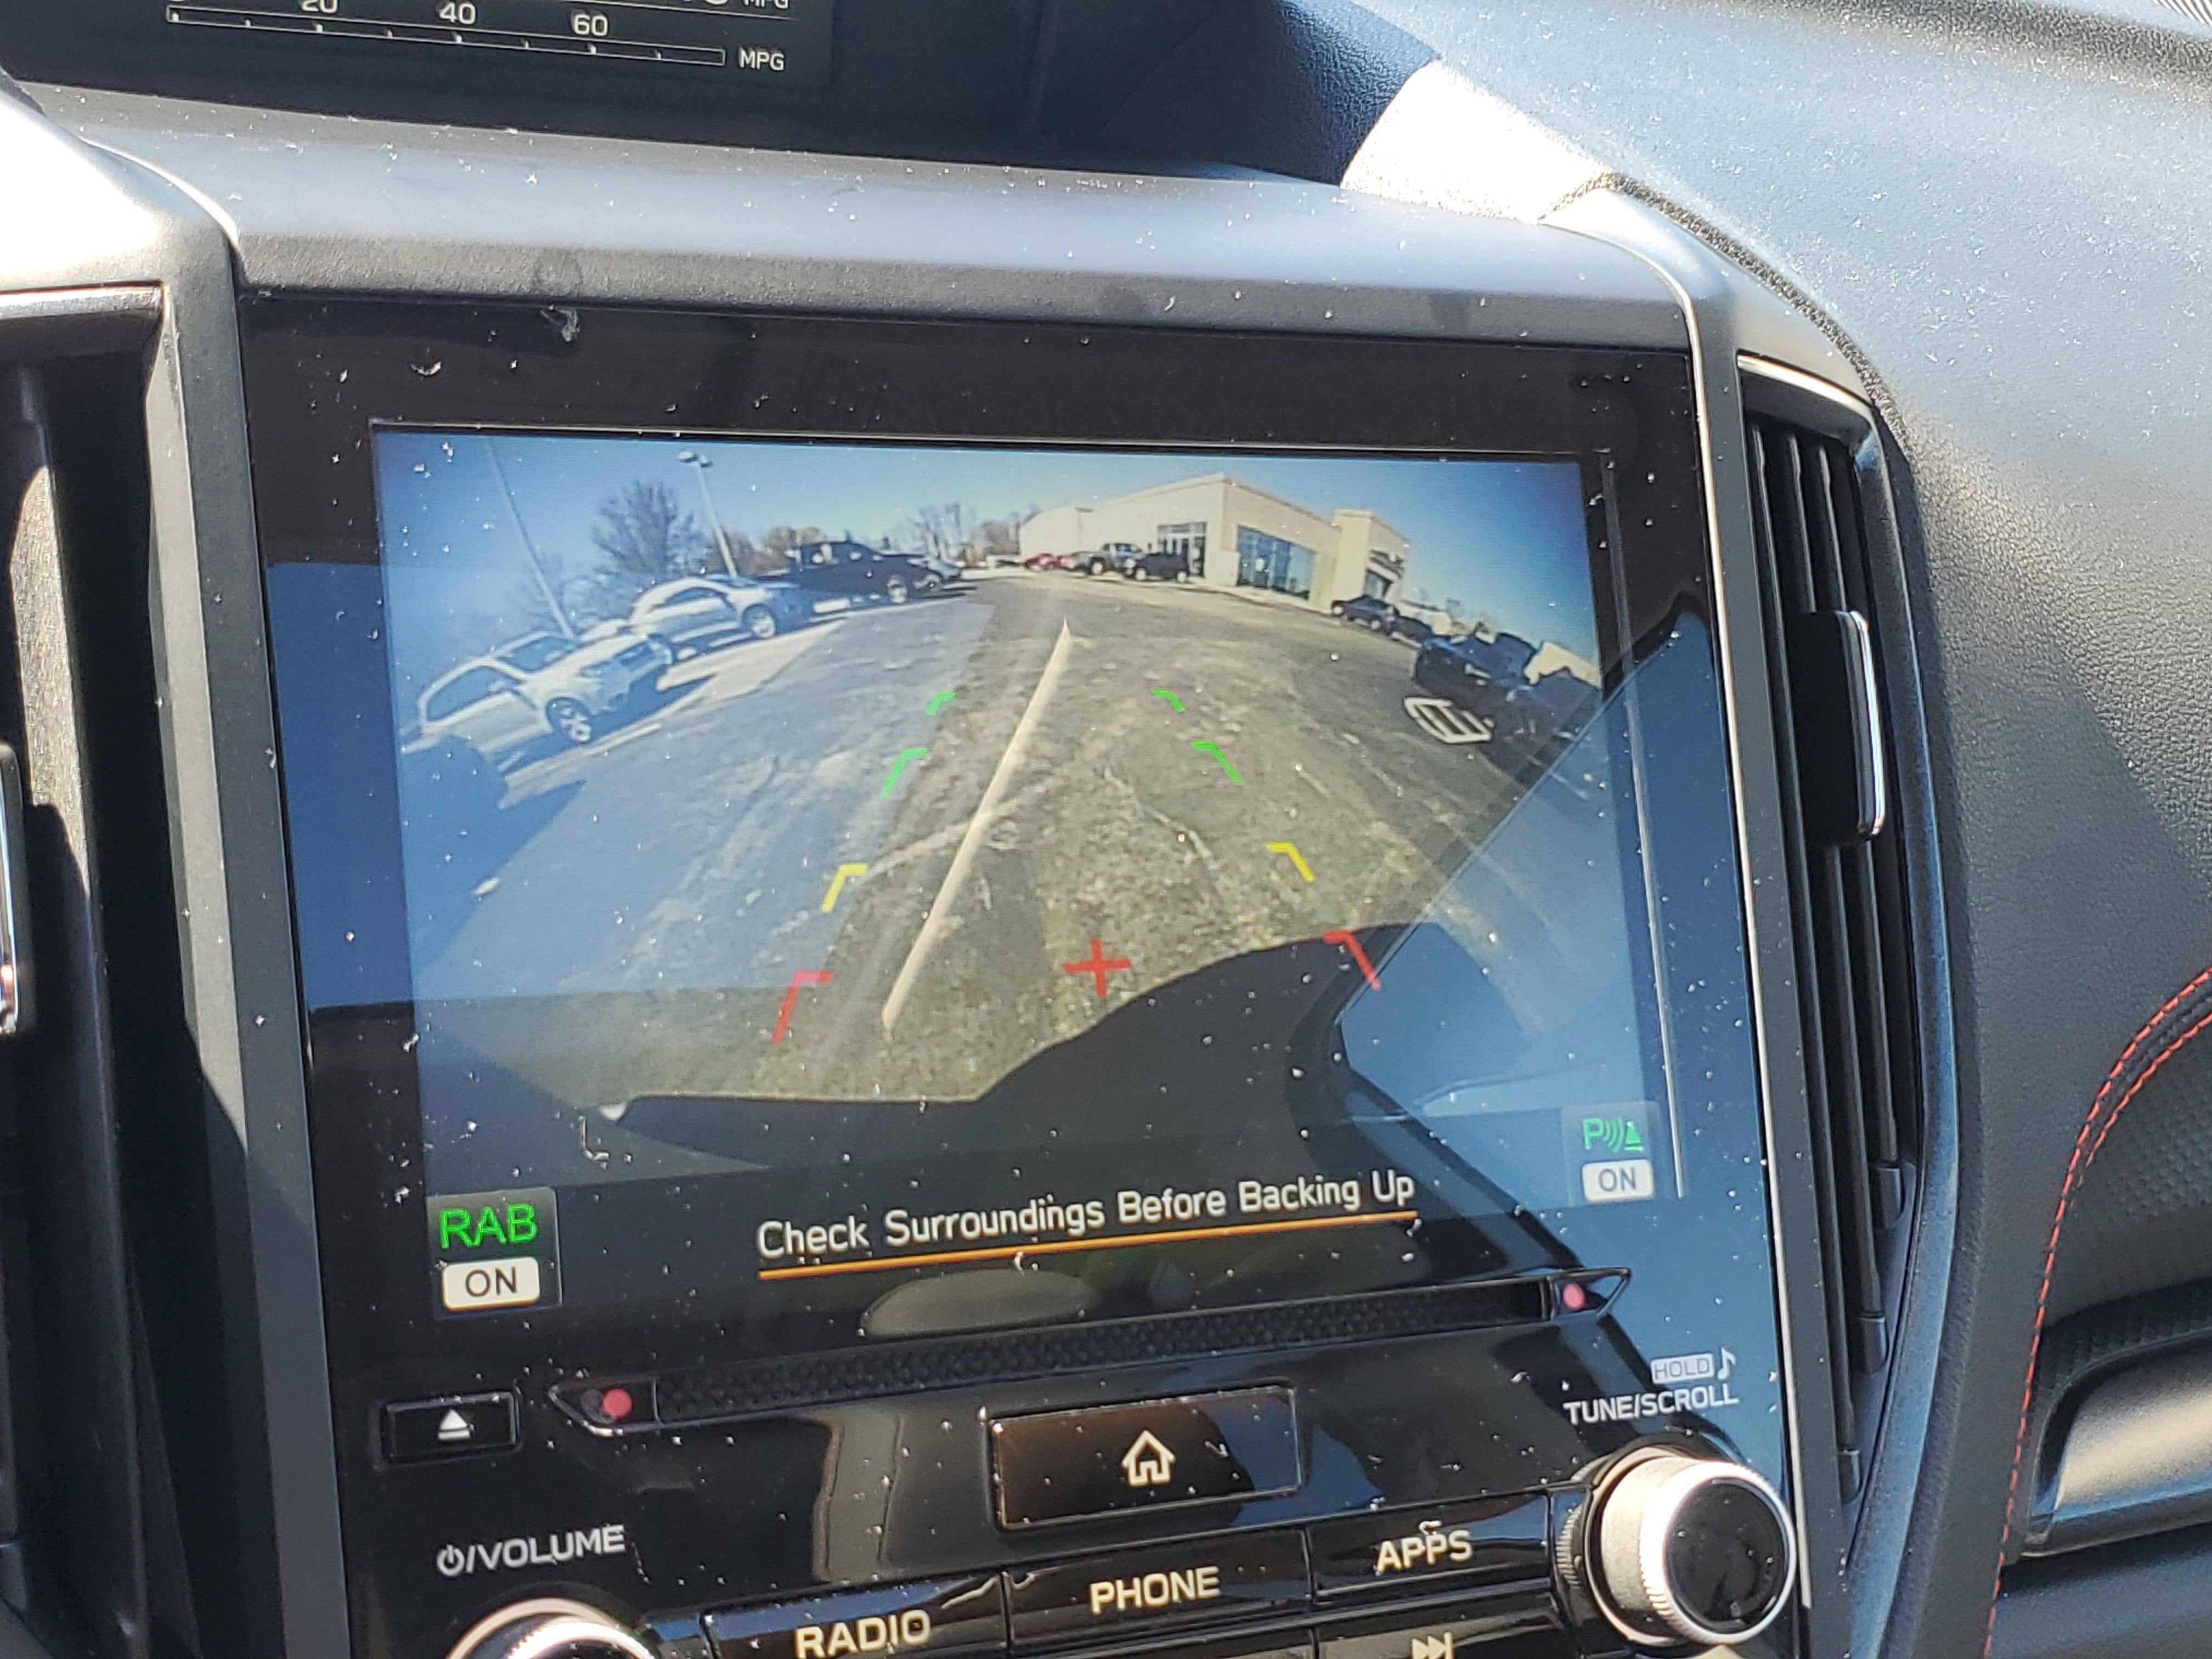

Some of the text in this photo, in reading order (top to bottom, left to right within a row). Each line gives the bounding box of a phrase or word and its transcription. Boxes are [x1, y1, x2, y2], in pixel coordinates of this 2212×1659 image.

[439, 2, 477, 25] 40
[574, 14, 608, 37] 60
[739, 48, 785, 71] MPG
[1598, 1166, 1637, 1192] ON
[439, 1203, 538, 1249] RAB
[758, 1169, 1415, 1259] Check Surroundings Before Backing Up
[465, 1266, 518, 1297] ON
[1654, 1358, 1710, 1380] HOLD
[1562, 1383, 1739, 1426] TUNE/SCROLL
[1376, 1530, 1472, 1573] APPS
[1090, 1566, 1222, 1615] PHONE
[795, 1609, 931, 1659] RADIO
